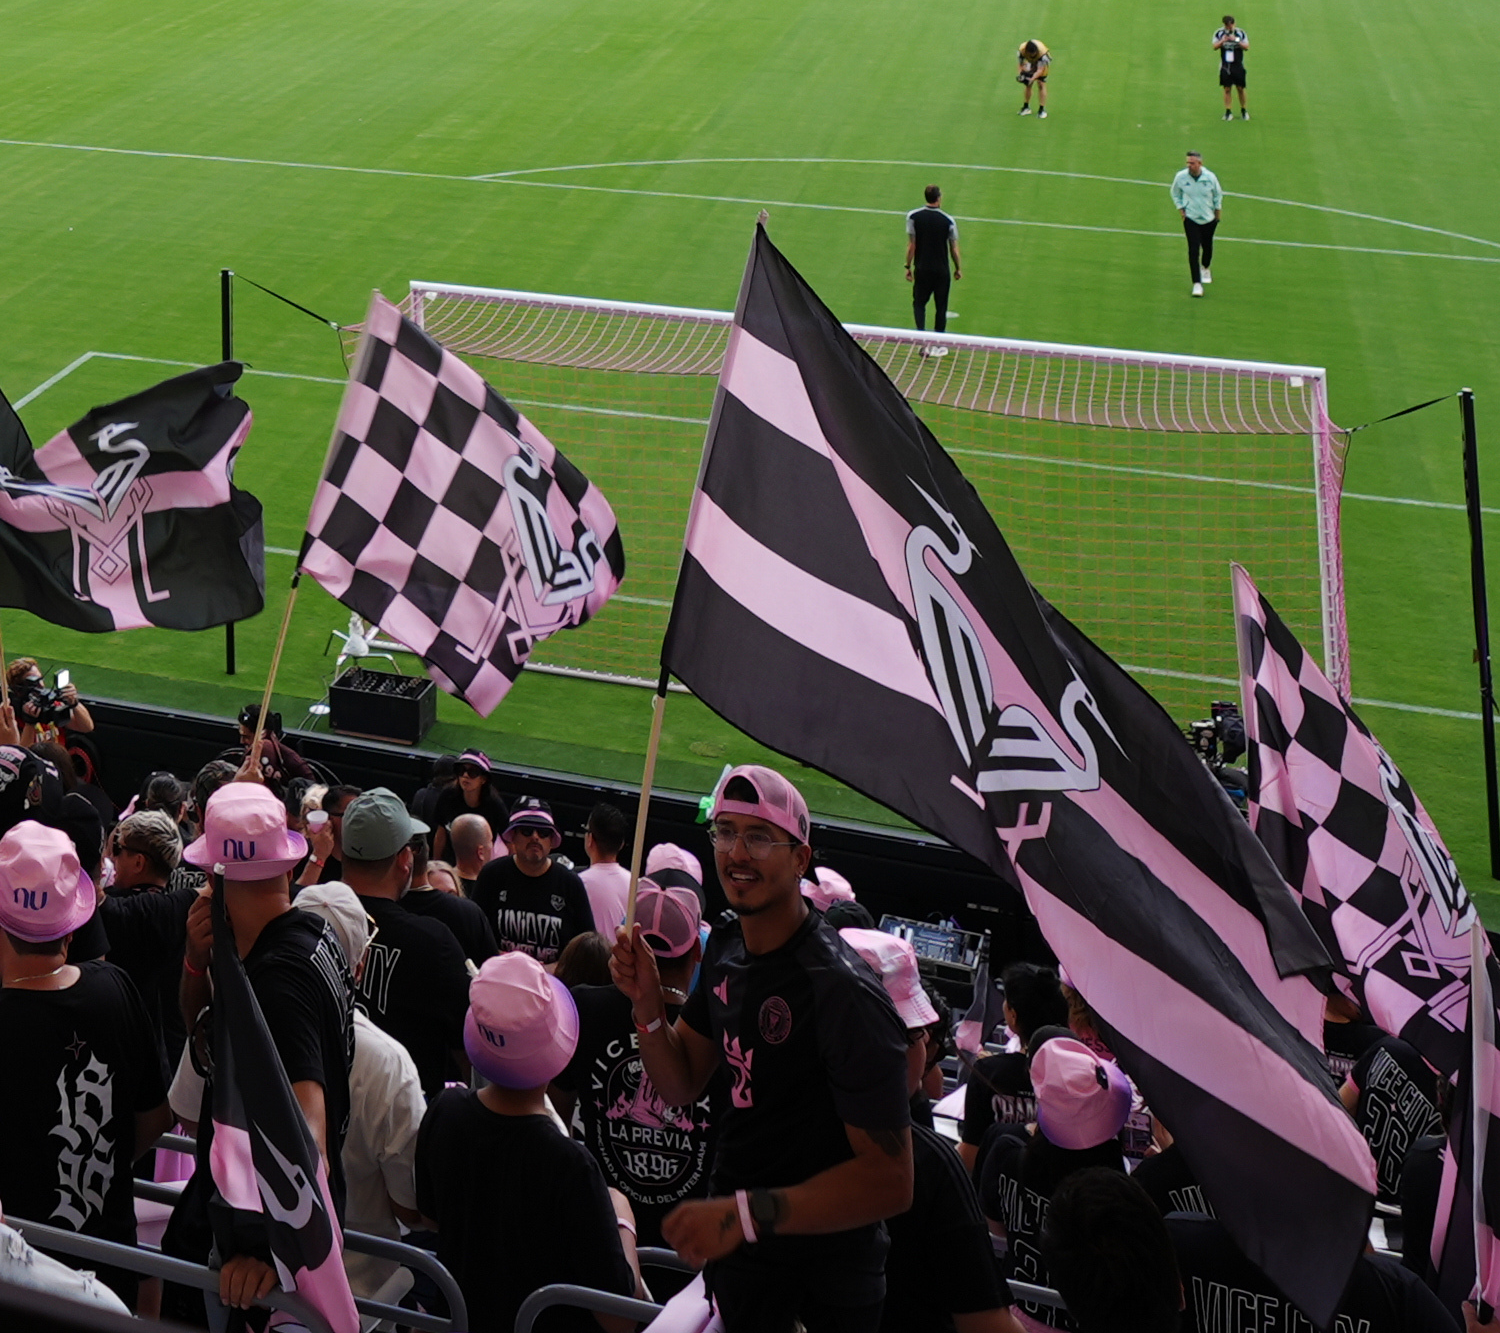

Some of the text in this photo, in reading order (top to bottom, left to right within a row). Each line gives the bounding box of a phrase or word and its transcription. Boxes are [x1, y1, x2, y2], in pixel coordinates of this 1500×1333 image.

[609, 1122, 694, 1152] LA PREVIA
[618, 1182, 657, 1206] OFICIAL
[658, 1194, 677, 1206] DEL
[677, 1172, 699, 1201] INTER
[693, 1141, 708, 1174] MIAMI
[621, 1149, 680, 1181] 1896
